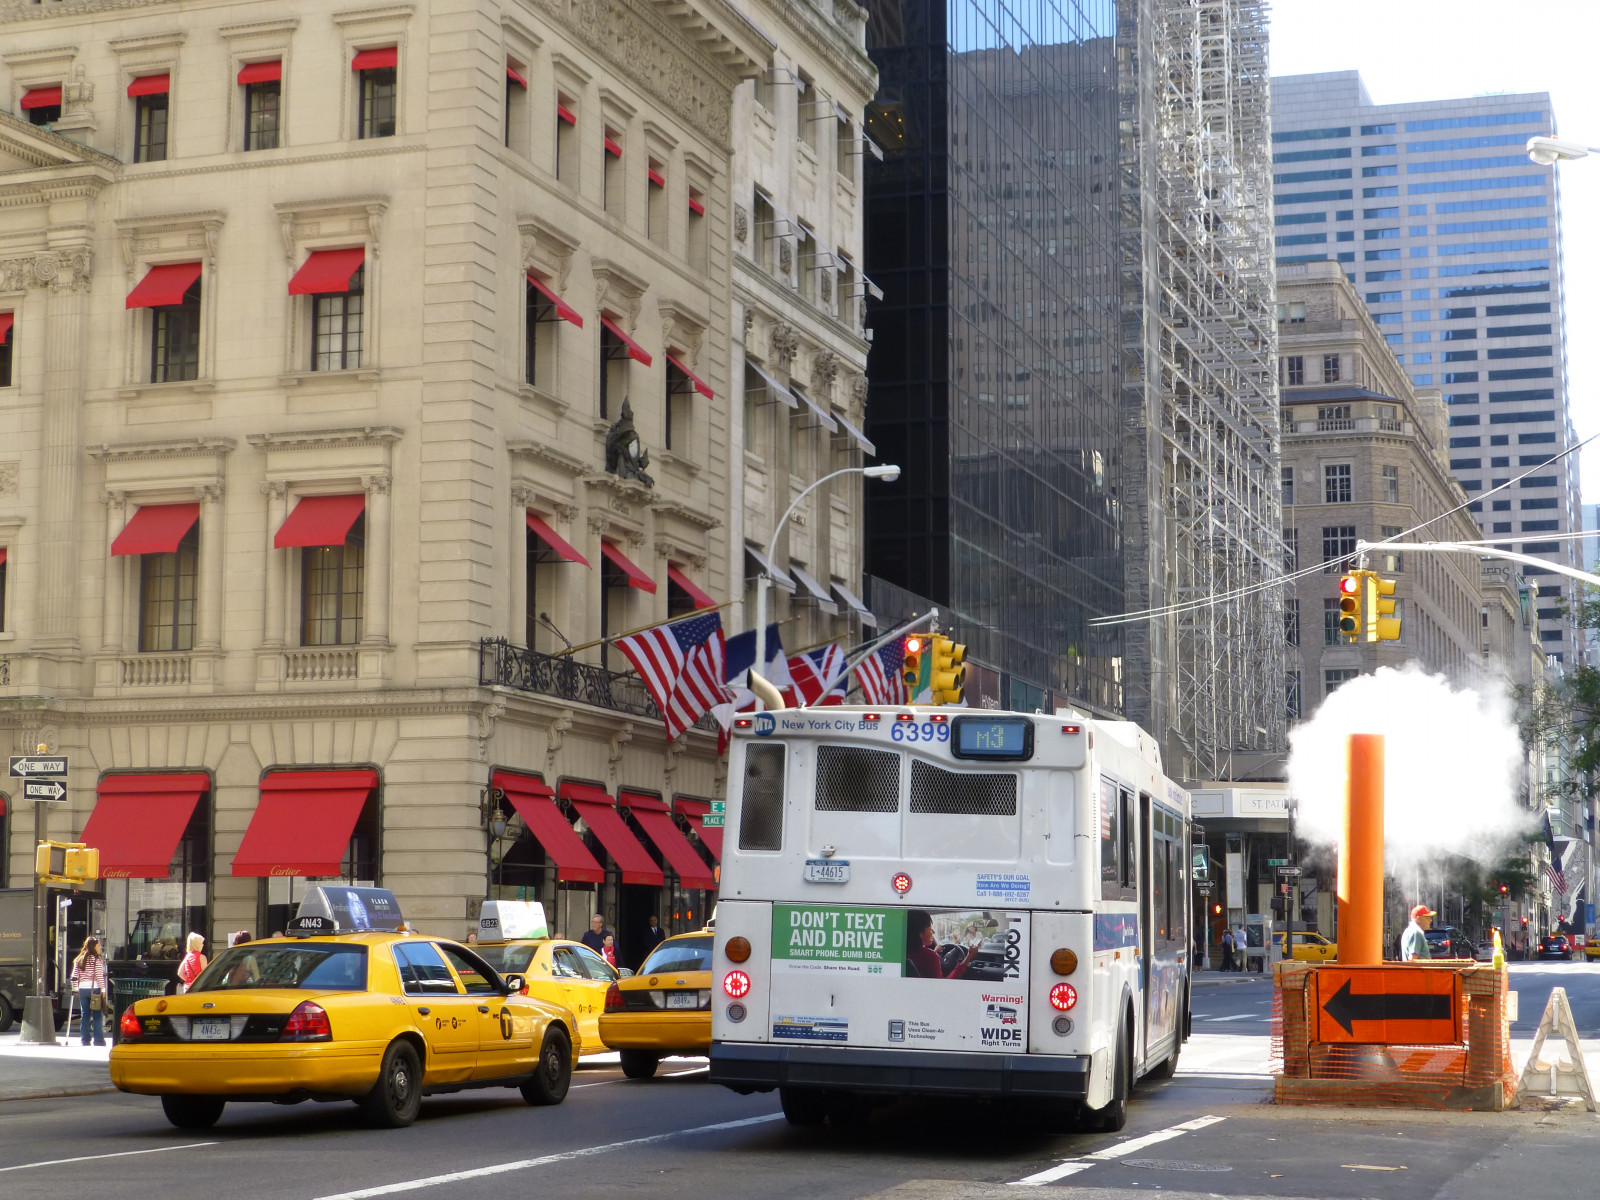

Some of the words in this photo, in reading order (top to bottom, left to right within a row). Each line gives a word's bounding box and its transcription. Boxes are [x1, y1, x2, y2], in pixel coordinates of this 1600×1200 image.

[755, 716, 773, 732] MTA
[782, 720, 805, 730] New
[808, 720, 831, 730] York
[835, 721, 855, 732] City
[858, 720, 879, 731] Bus
[891, 722, 950, 742] 6399
[19, 762, 35, 771] ONE
[43, 763, 60, 771] WAY
[30, 786, 42, 794] ONE
[48, 786, 61, 796] WAY
[712, 802, 719, 812] E
[704, 816, 720, 825] PLACE
[102, 866, 131, 878] Cartier
[270, 865, 301, 876] Cartier
[300, 918, 322, 928] 4N43
[790, 911, 840, 928] DON'T
[844, 912, 886, 930] TEXT
[789, 929, 827, 947] AND
[832, 930, 884, 949] DRIVE
[789, 949, 814, 957] SMART
[815, 949, 841, 958] PHONE.
[842, 950, 863, 958] DUMB
[865, 951, 883, 959] IDEA.
[982, 994, 1024, 1004] Warning!
[908, 1033, 936, 1041] Technology
[981, 1027, 1022, 1041] WIDE
